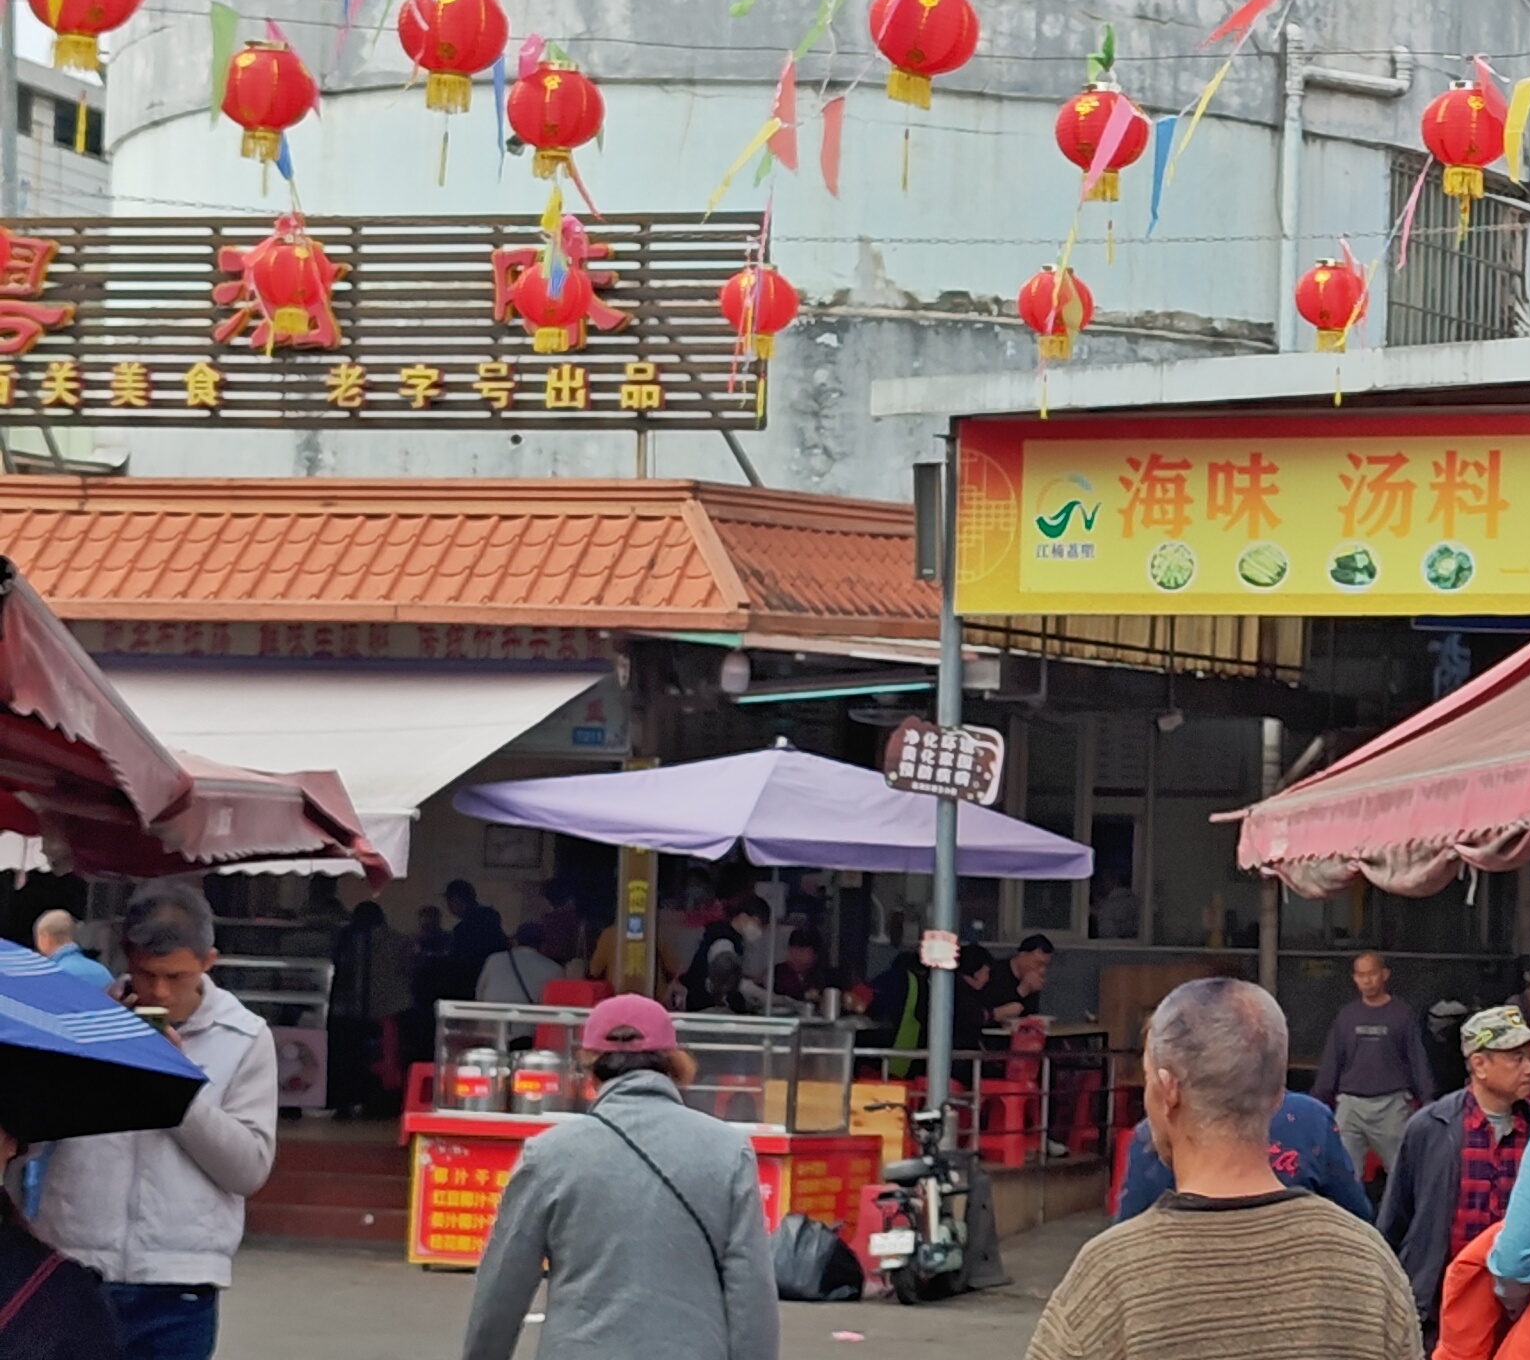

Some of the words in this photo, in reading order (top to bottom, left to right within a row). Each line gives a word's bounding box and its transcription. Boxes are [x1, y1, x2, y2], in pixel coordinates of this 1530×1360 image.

[326, 362, 664, 410] 老字号出品
[1117, 450, 1282, 539] 海味
[1336, 449, 1510, 539] 汤料
